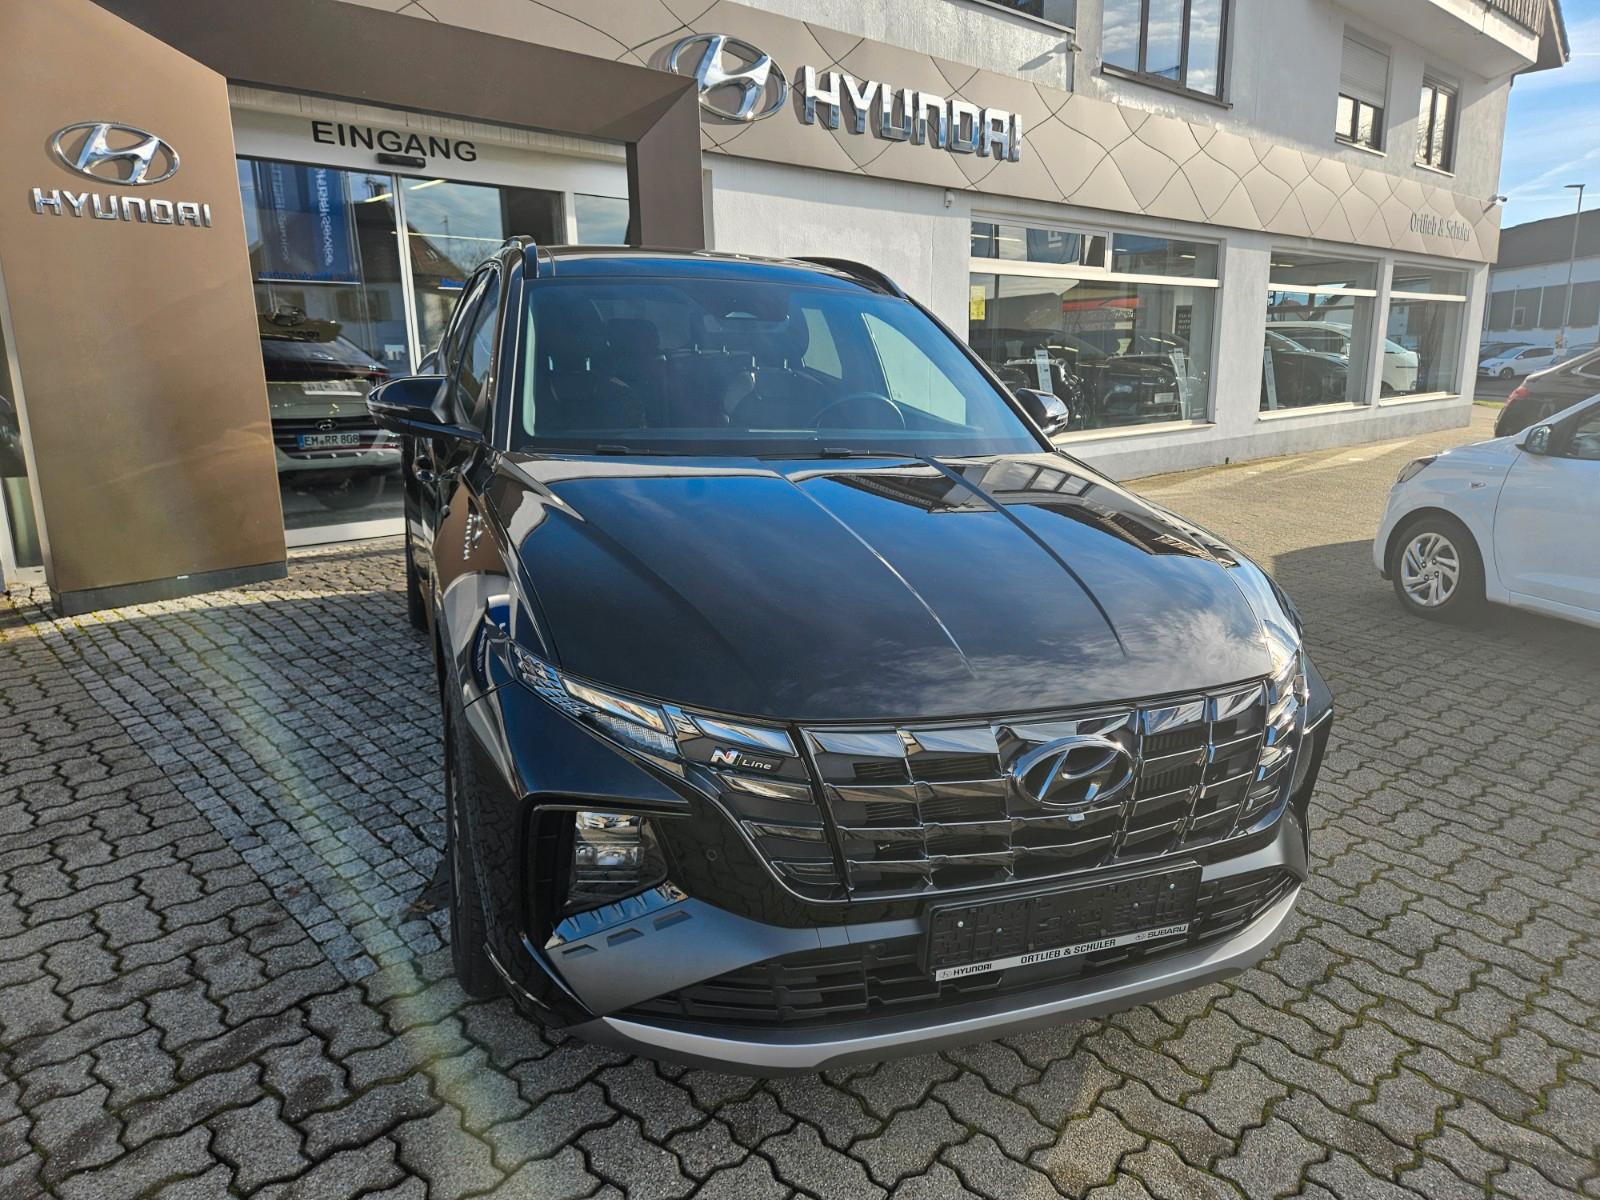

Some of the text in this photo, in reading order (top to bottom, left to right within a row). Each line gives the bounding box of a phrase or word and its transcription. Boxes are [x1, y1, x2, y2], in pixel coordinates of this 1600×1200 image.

[802, 65, 1022, 162] HYUNDAI
[311, 120, 477, 162] EINGANG
[31, 187, 212, 228] HYUNDAI
[304, 436, 319, 446] EM
[325, 435, 338, 445] RR
[741, 759, 772, 770] Line
[1147, 925, 1186, 939] SUBARU
[1020, 949, 1061, 964] ORTLIEB
[1063, 947, 1072, 956] &
[953, 962, 992, 977] HYUNDAI
